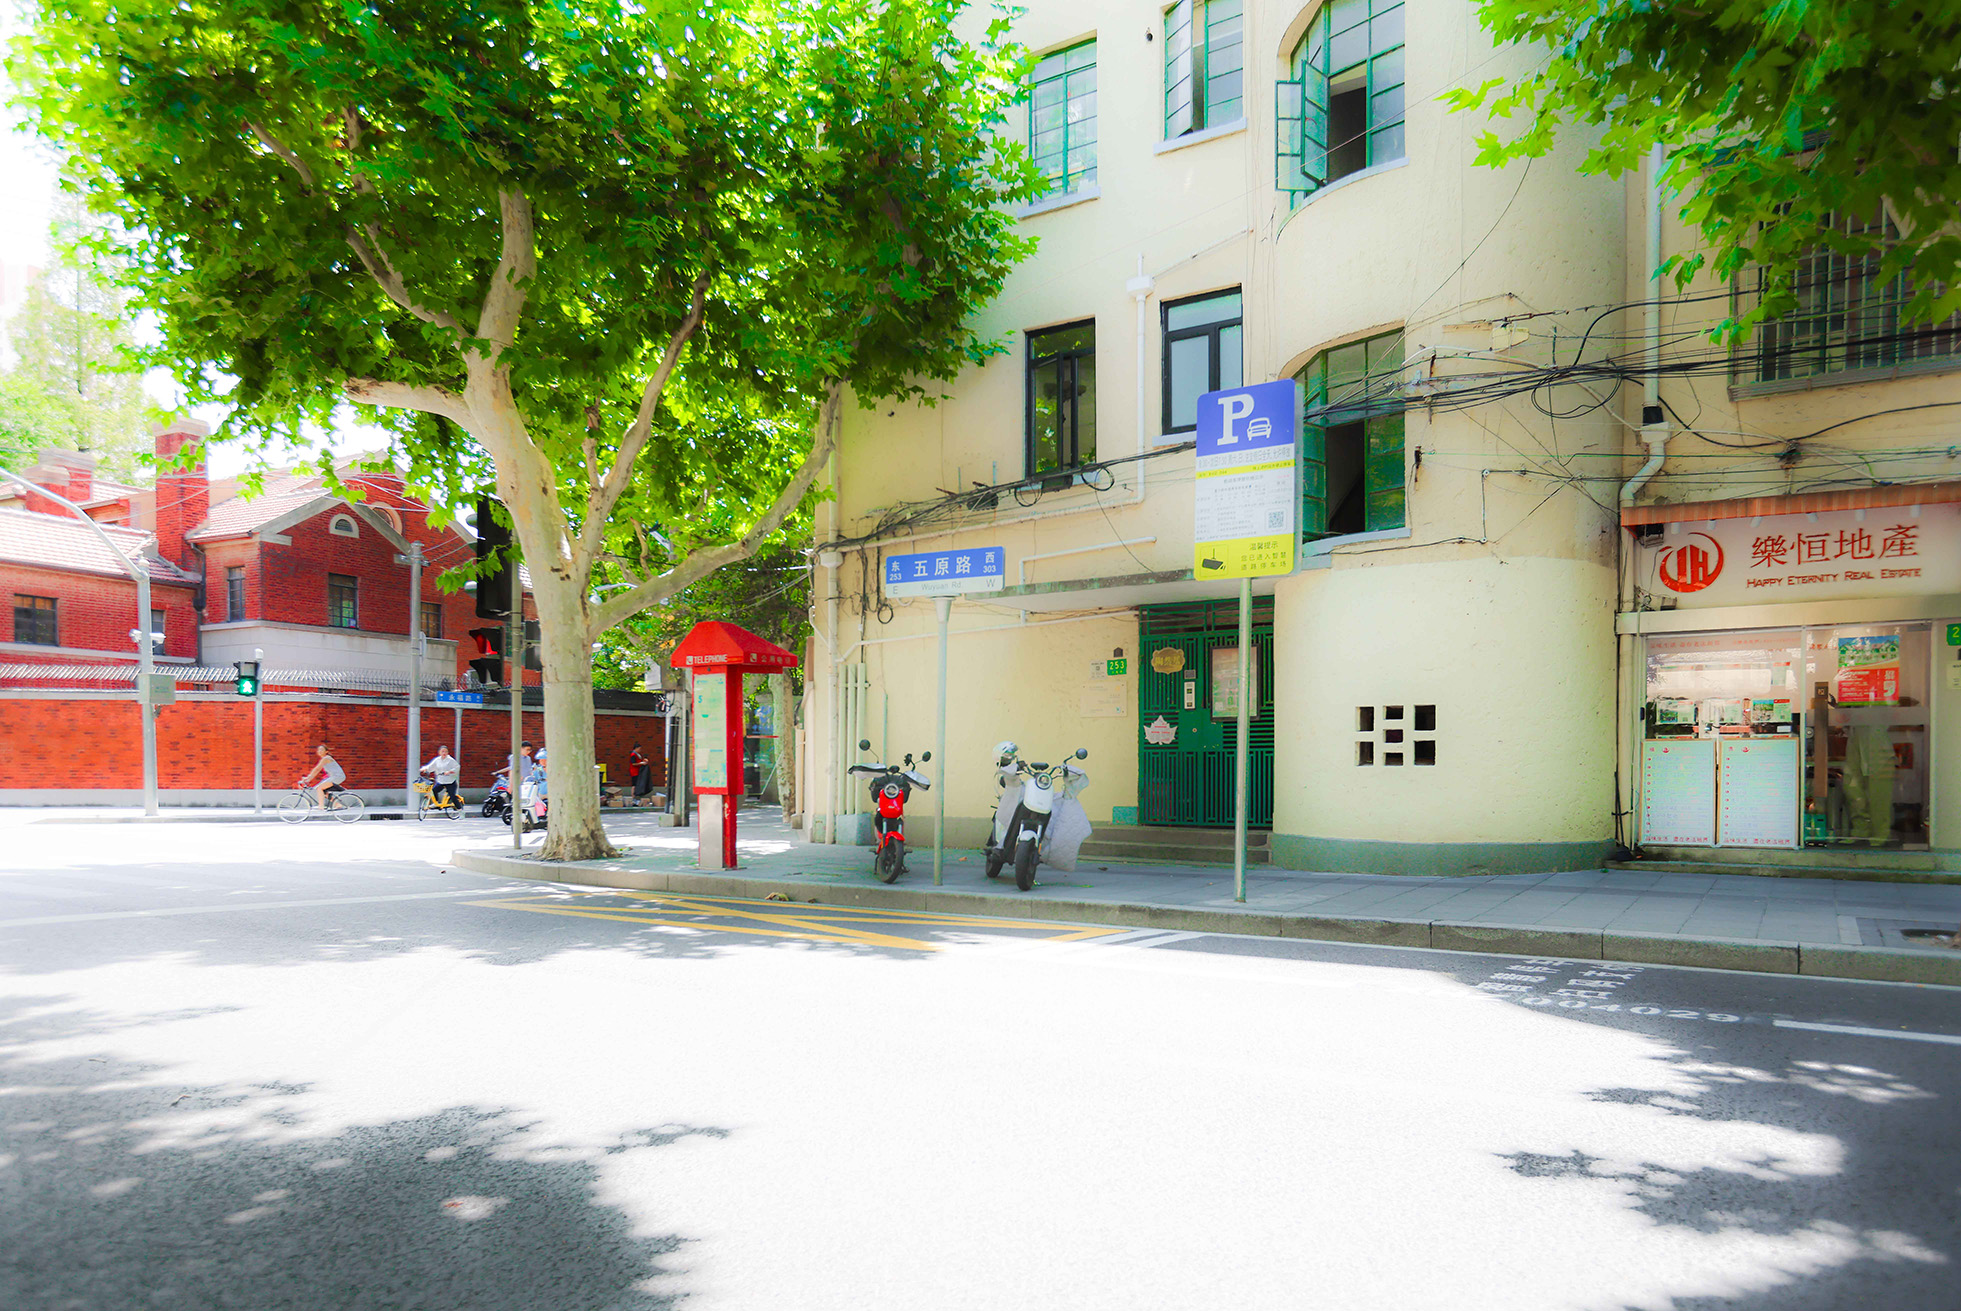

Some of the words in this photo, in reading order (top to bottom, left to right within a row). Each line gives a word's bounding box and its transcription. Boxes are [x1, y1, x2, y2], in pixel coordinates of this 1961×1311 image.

[1217, 393, 1255, 446] P
[985, 551, 995, 564] 西
[891, 561, 901, 572] 东
[913, 555, 971, 577] 五原路
[982, 564, 997, 574] 303
[889, 573, 902, 581] 253
[1746, 577, 1783, 588] HAPPY
[1787, 573, 1839, 586] ETERNITY
[1844, 570, 1875, 581] REAL
[1880, 568, 1922, 579] ESTATE
[986, 579, 996, 588] W
[892, 585, 899, 595] E
[694, 654, 728, 664] TELEPHONE
[1109, 660, 1125, 670] 253
[1521, 996, 1742, 1023] 004029
